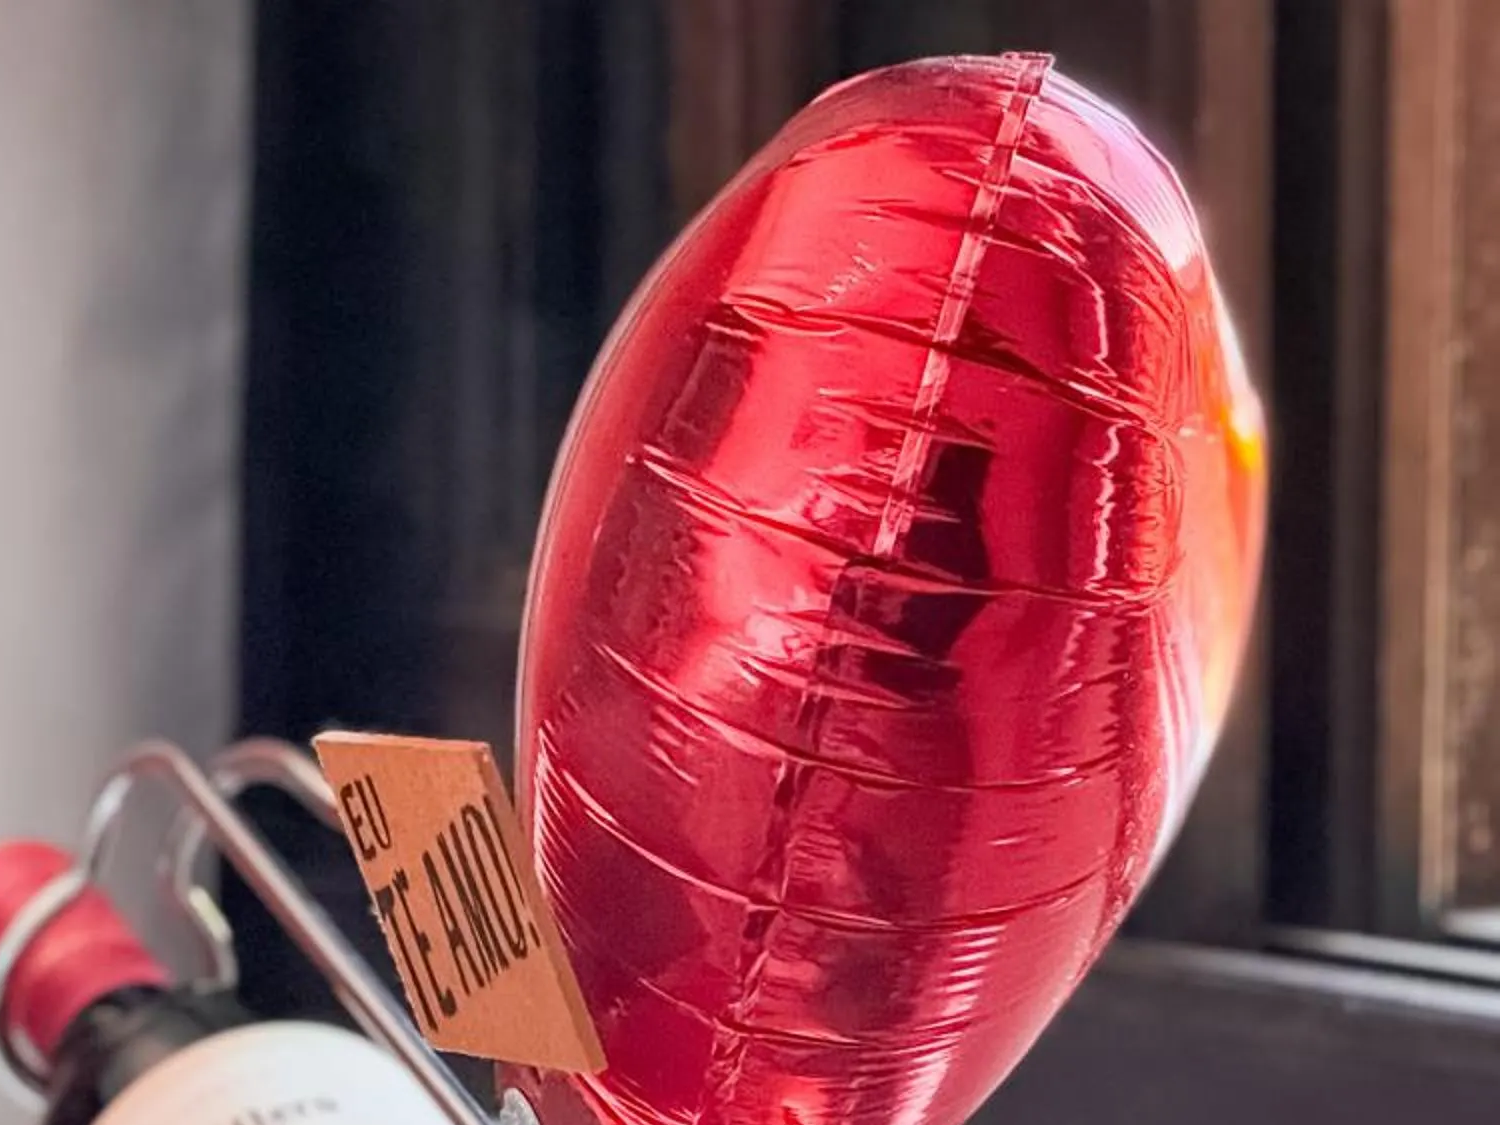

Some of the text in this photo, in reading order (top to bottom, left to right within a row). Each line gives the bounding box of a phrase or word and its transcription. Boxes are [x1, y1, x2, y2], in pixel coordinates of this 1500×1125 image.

[340, 775, 392, 861] EU
[374, 795, 541, 1032] TE AMO!
